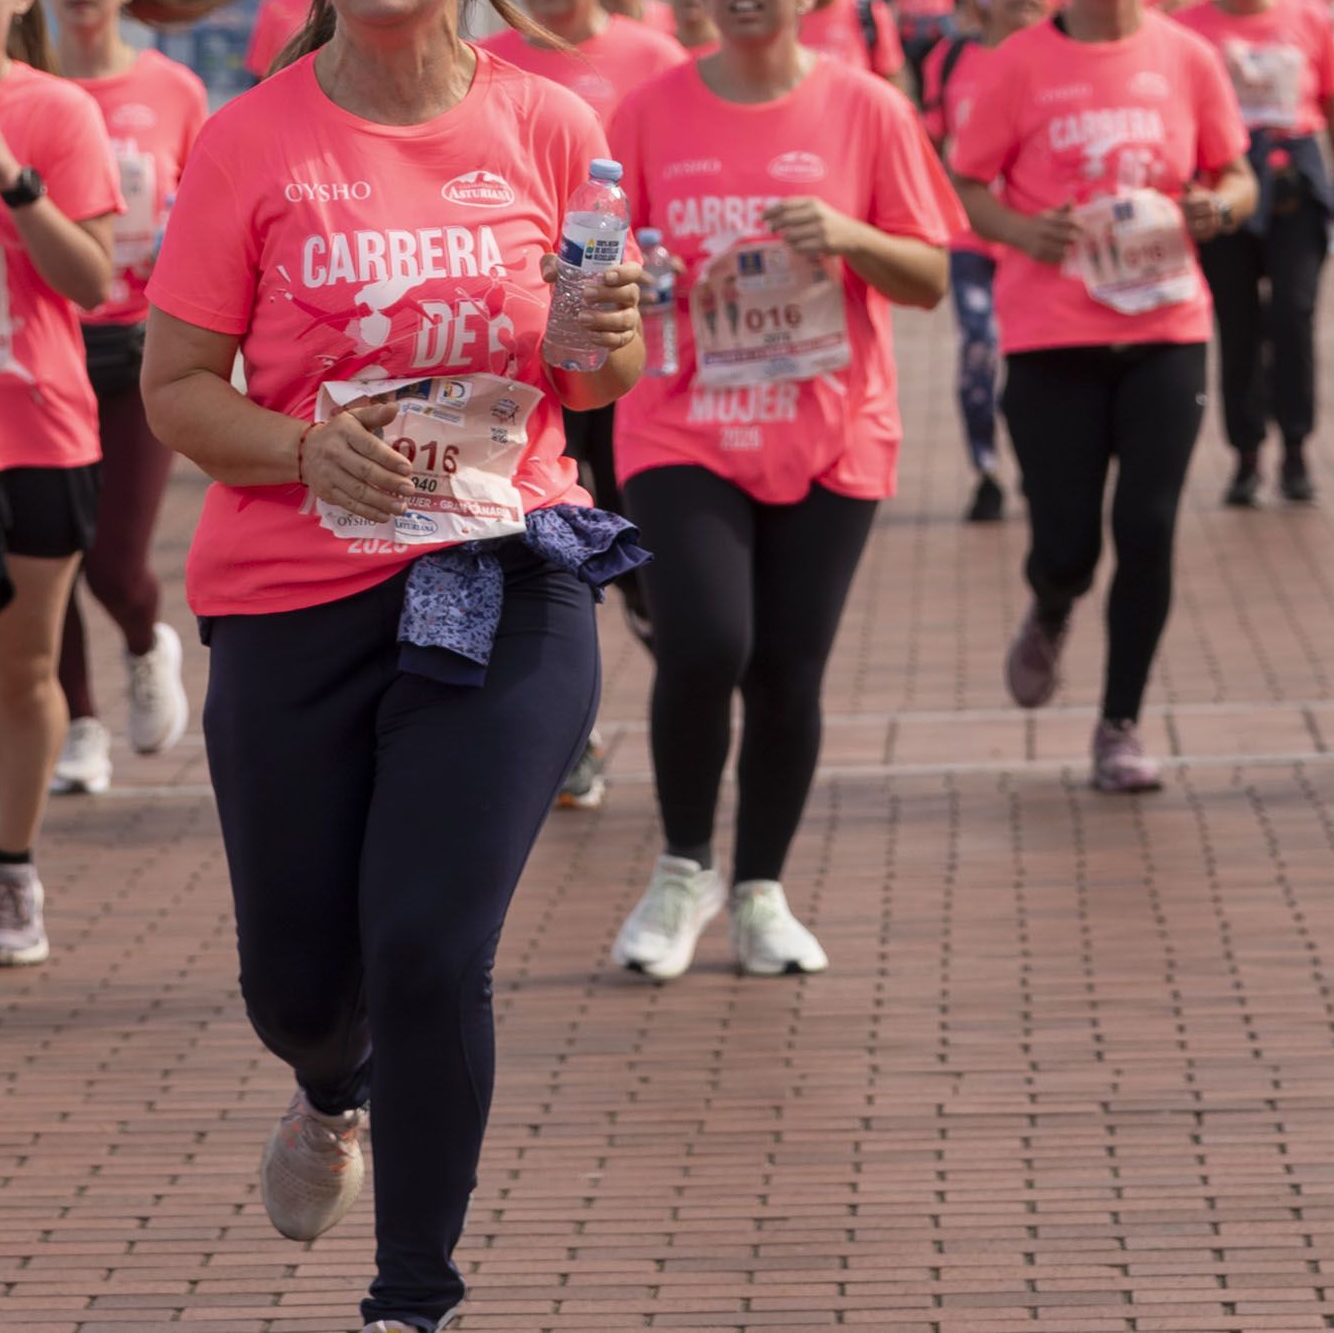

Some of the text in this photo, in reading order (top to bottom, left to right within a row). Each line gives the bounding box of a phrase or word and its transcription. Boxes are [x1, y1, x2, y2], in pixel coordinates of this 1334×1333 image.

[285, 181, 371, 202] OYSHO
[302, 226, 507, 288] CARRERA
[411, 299, 484, 368] DE
[746, 304, 802, 333] 016
[687, 382, 799, 423] MUJER
